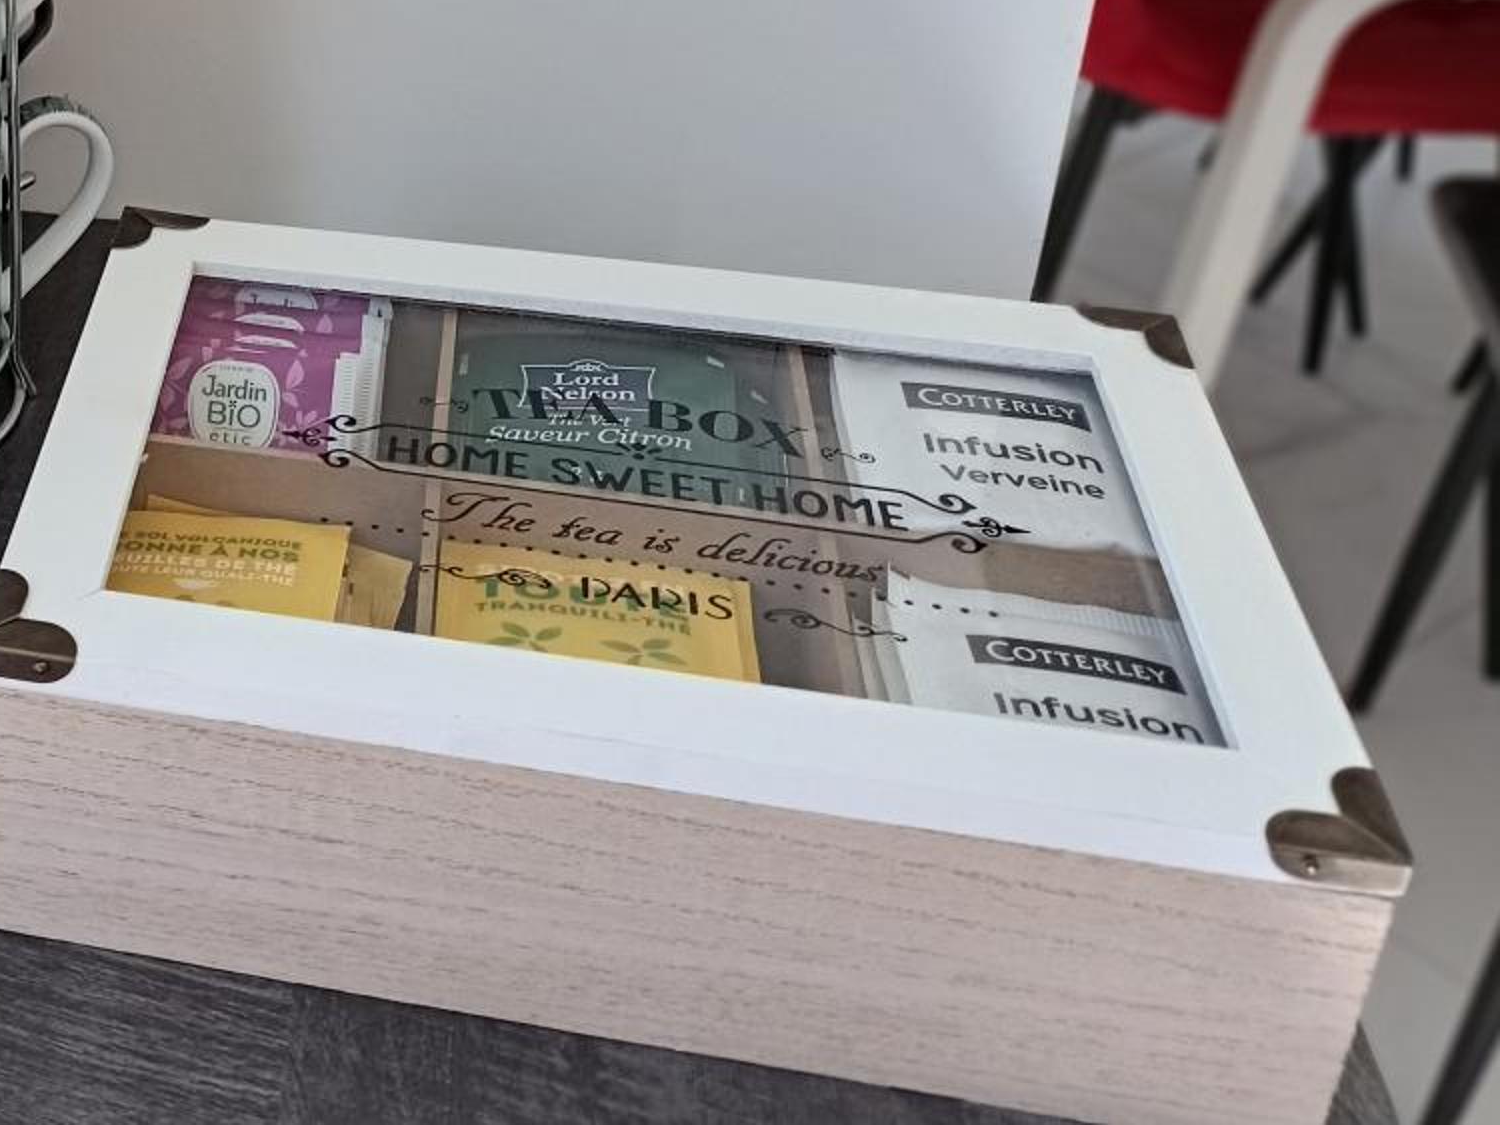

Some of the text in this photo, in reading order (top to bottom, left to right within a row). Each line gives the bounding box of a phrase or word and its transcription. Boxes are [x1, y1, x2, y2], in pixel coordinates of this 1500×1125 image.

[202, 375, 267, 402] Jardin
[553, 372, 619, 386] Lord
[472, 388, 807, 458] TEA BOX
[485, 425, 693, 452] Saveur Citron
[923, 432, 1105, 474] Infusion
[387, 436, 529, 480] HOME
[550, 457, 732, 506] SWEET
[751, 483, 909, 532] HOME
[940, 463, 1106, 499] Verveine
[238, 547, 300, 563] NOS
[421, 491, 884, 583] The tea is delicious
[581, 575, 733, 620] PARIS
[993, 692, 1205, 744] Infusion
